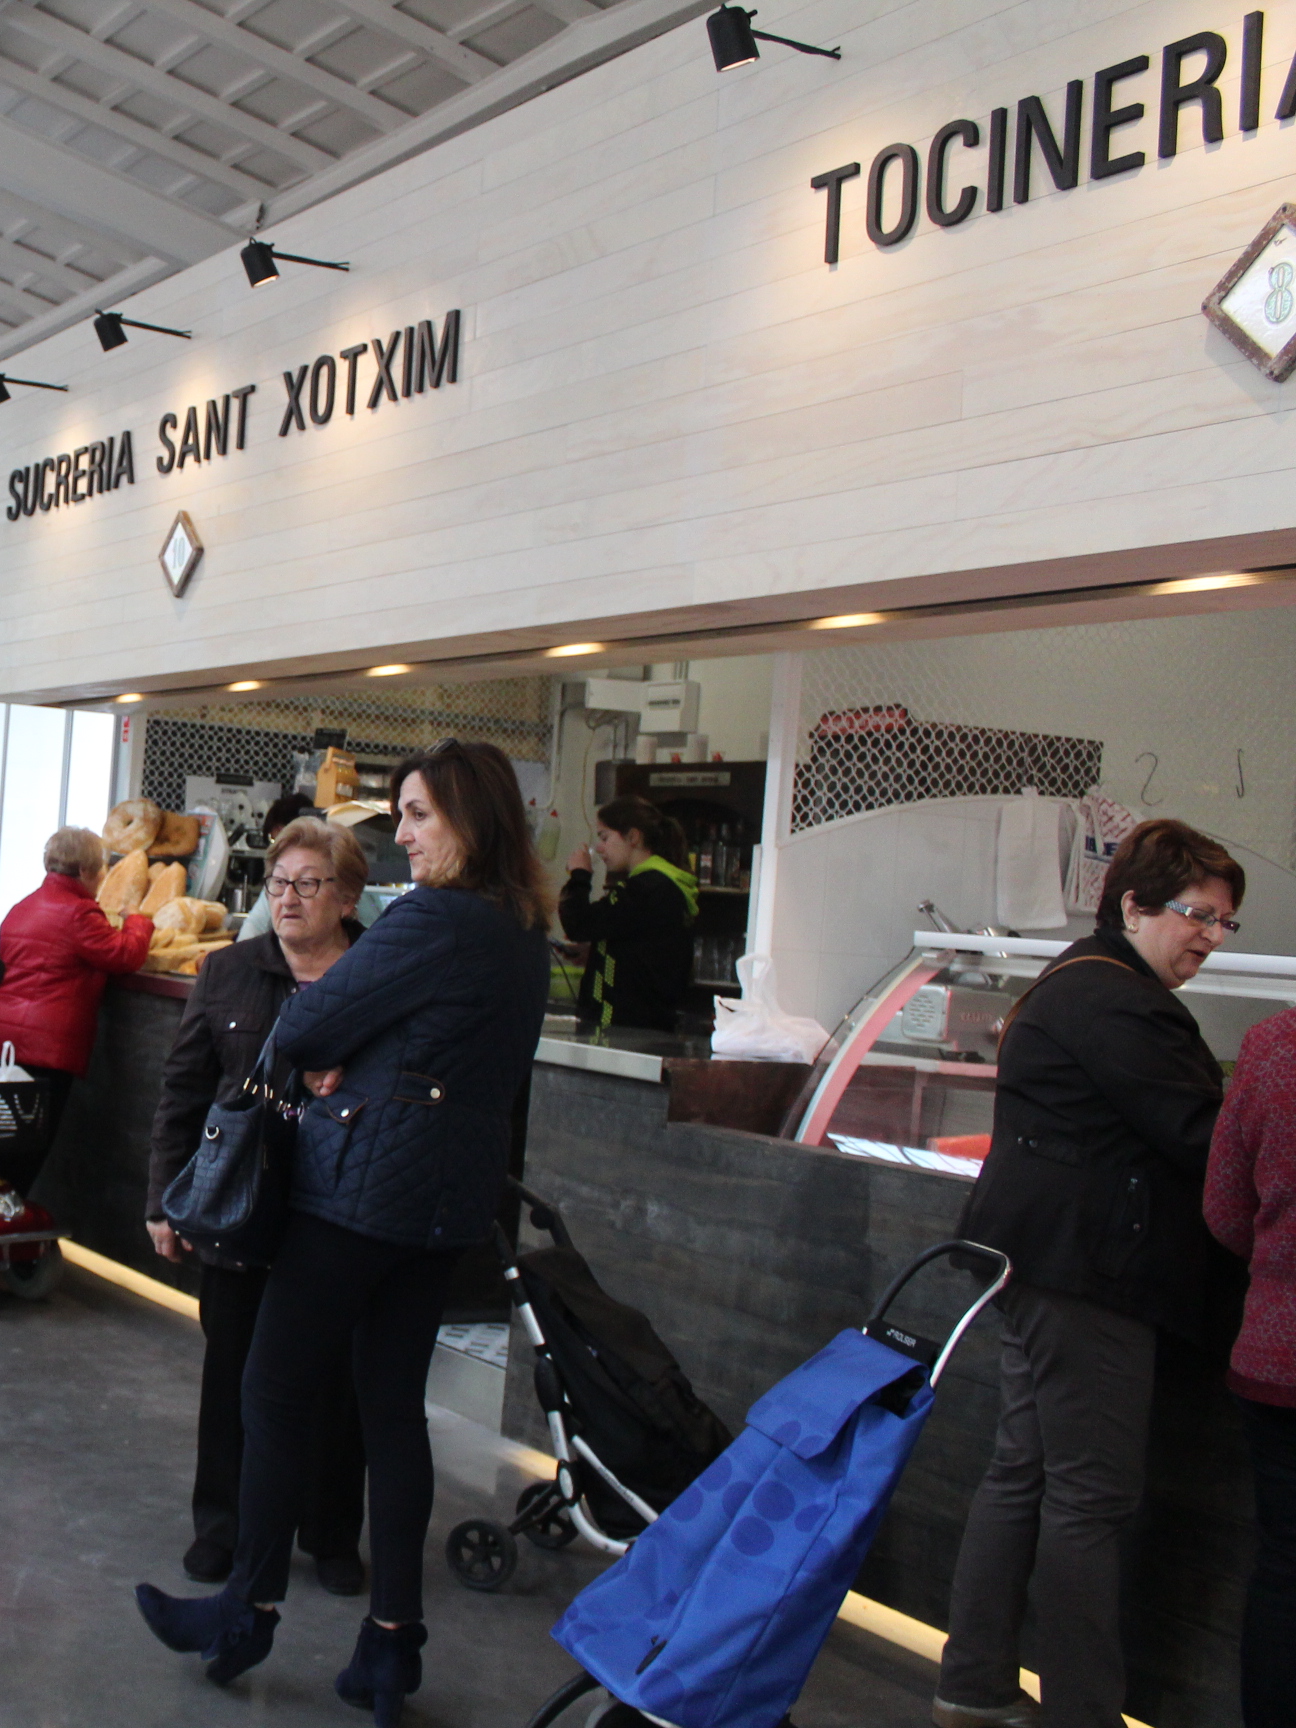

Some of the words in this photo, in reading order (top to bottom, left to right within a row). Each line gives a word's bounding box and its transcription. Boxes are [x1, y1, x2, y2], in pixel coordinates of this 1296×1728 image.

[1265, 262, 1294, 324] 8
[6, 430, 135, 521] SUCRERIA
[156, 384, 256, 474] SANT
[279, 309, 462, 437] XOTXIM
[173, 537, 185, 569] 10
